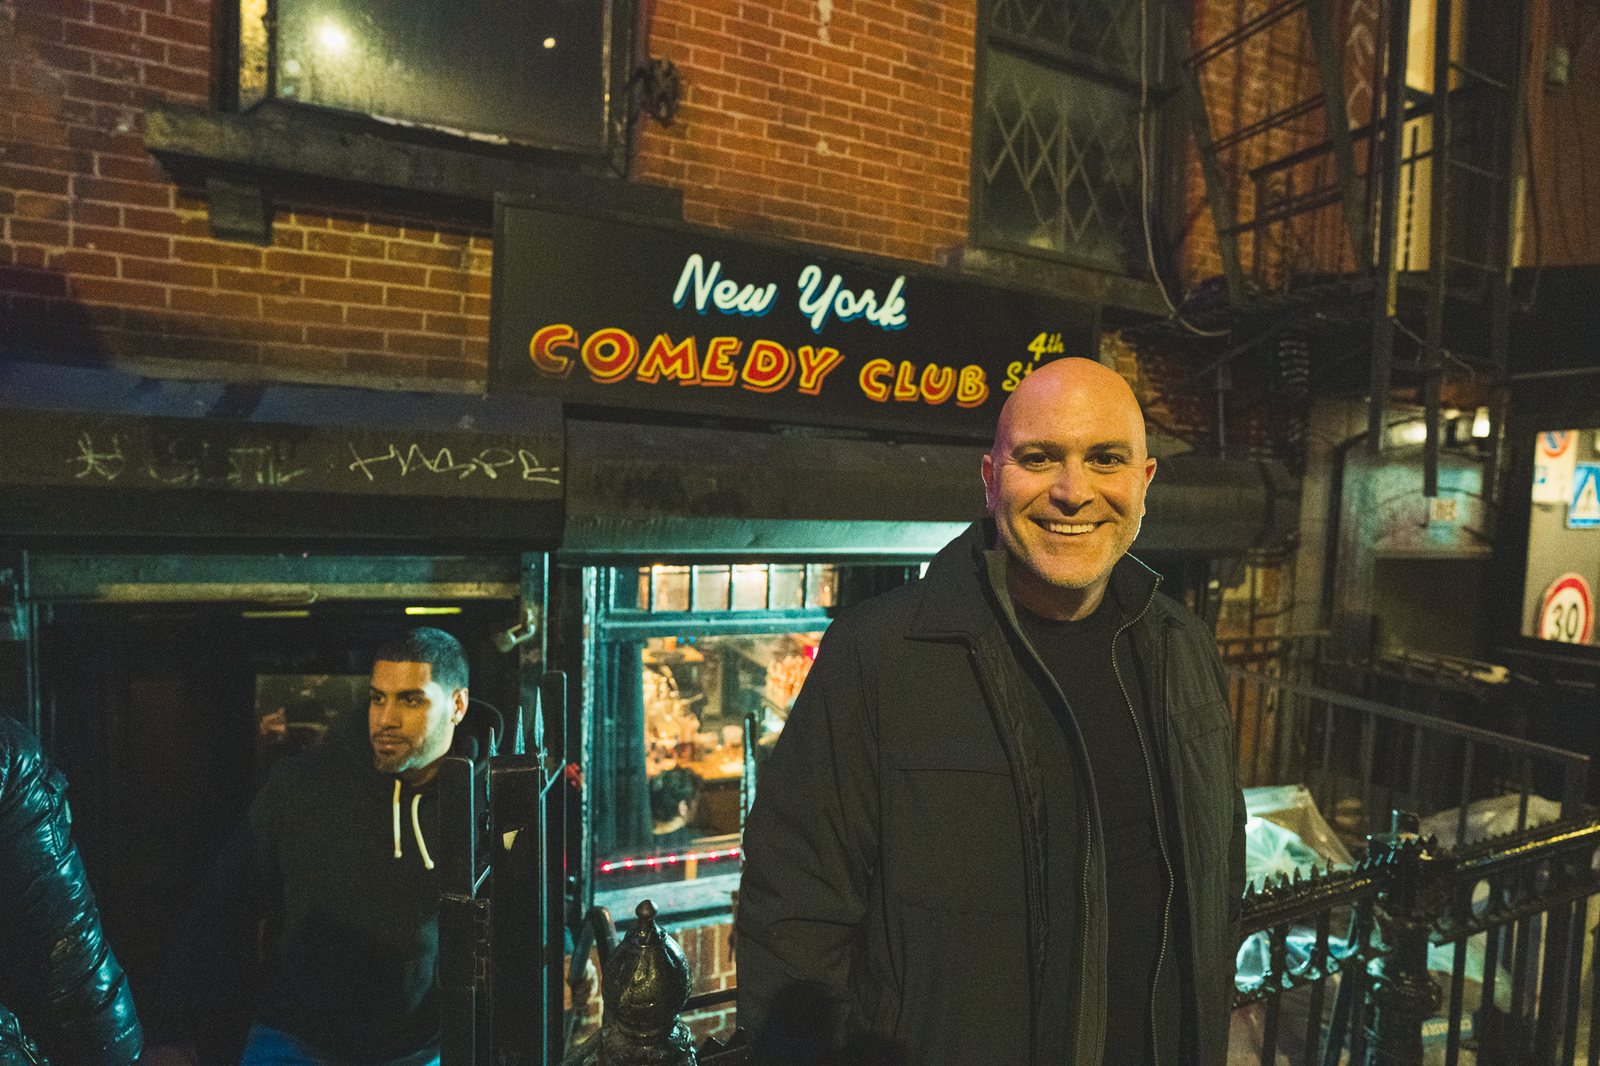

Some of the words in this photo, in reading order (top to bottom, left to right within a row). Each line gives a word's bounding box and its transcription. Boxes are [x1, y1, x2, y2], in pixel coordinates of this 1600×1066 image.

[673, 253, 777, 317] New
[798, 264, 908, 334] York
[529, 323, 845, 395] COMEDY
[859, 358, 989, 408] CLUB
[1027, 332, 1064, 362] 4th
[1552, 603, 1580, 640] 30
